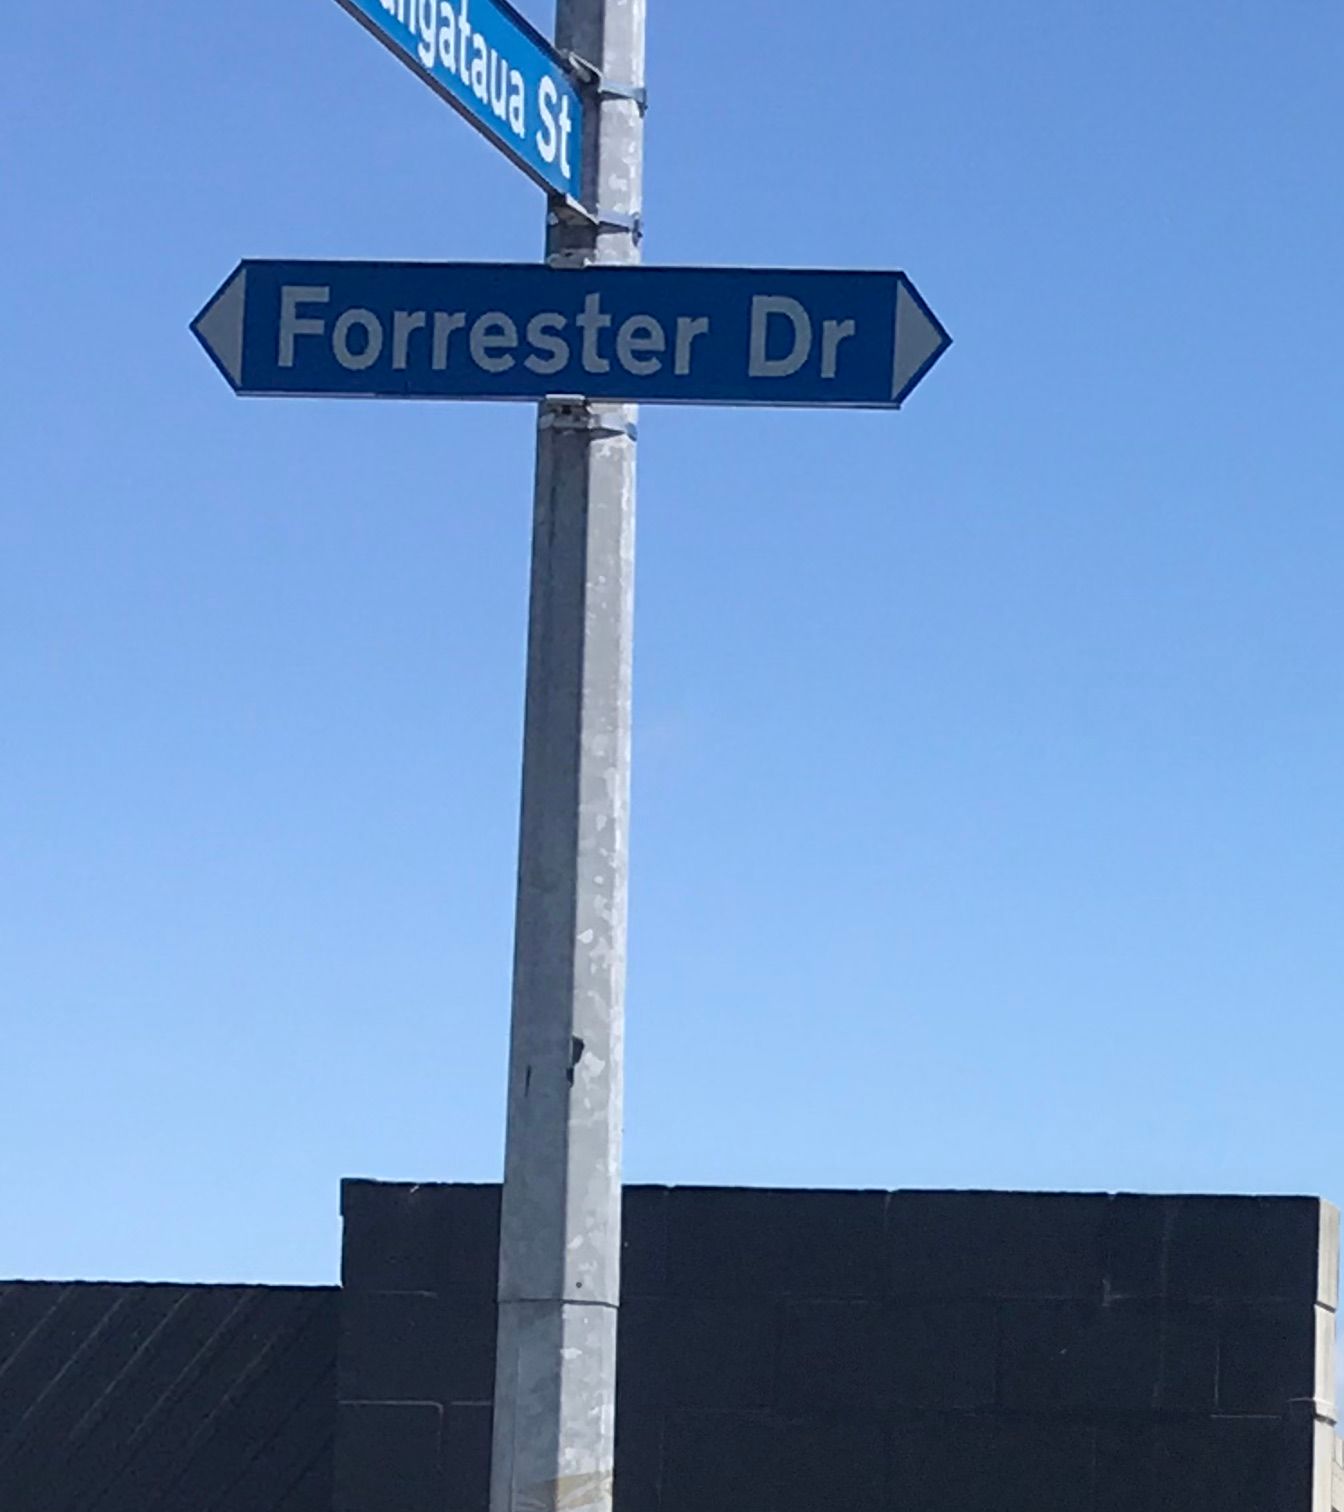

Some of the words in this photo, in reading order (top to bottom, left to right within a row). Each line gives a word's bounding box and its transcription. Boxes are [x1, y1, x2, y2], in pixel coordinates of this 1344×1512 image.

[379, 0, 525, 139] ngataua
[536, 75, 571, 179] St
[276, 285, 709, 376] Forrester
[748, 295, 856, 379] Dr
